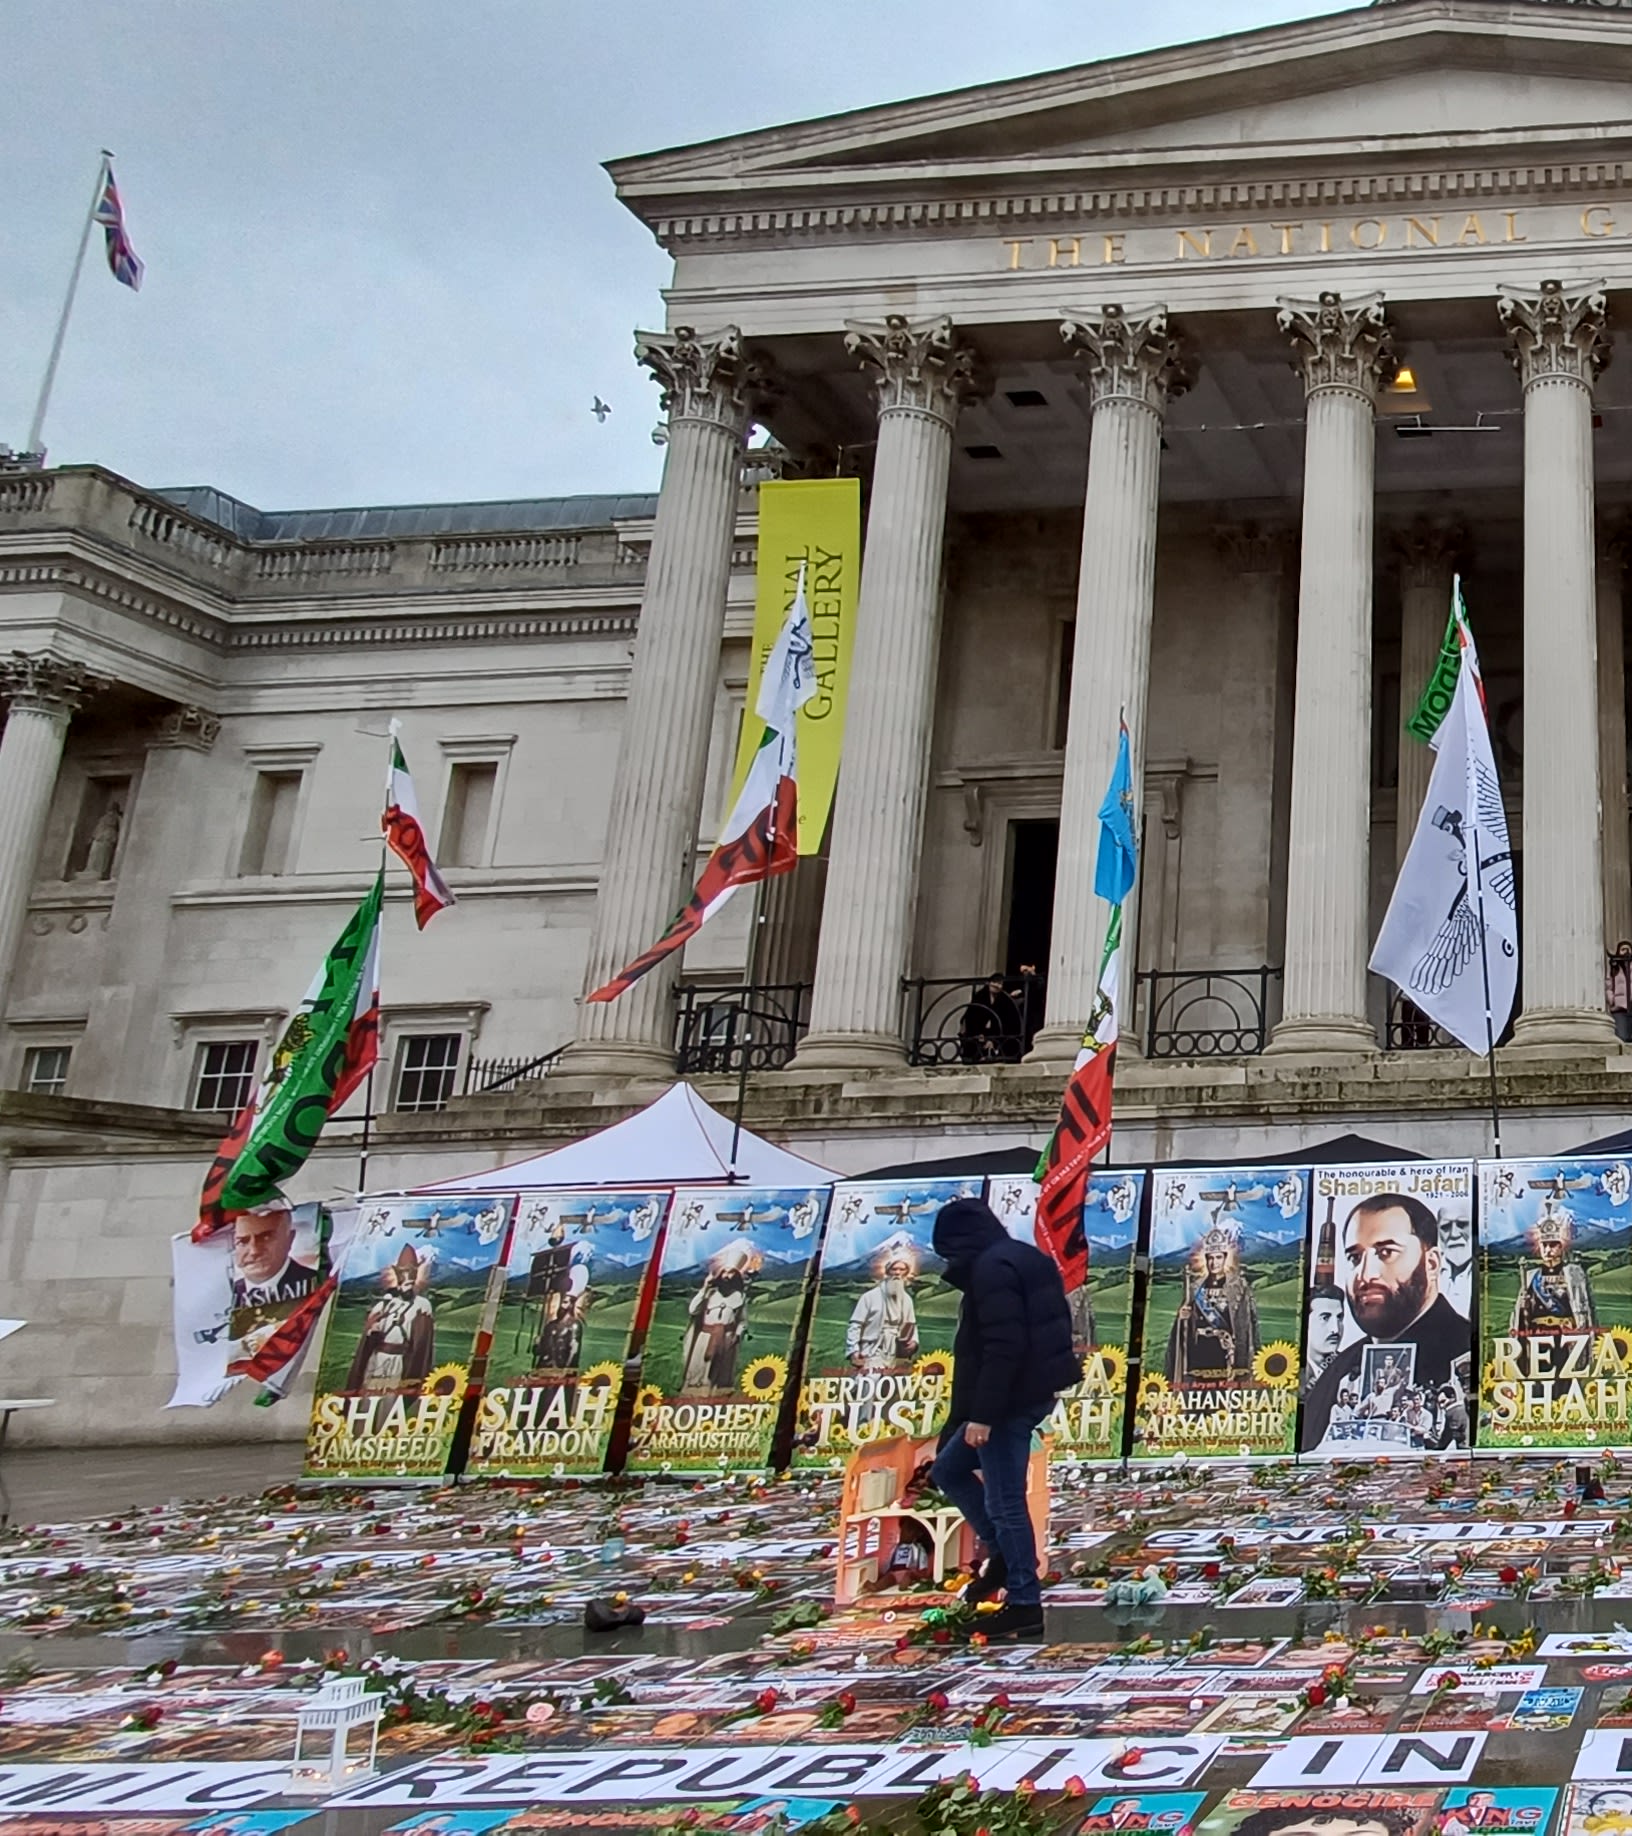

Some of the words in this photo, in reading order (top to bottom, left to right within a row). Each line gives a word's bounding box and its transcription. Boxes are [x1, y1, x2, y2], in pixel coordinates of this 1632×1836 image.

[1003, 236, 1126, 272] THE
[1177, 209, 1530, 263] NATIONAL
[1318, 1170, 1335, 1179] The
[1339, 1167, 1396, 1178] honourable
[1400, 1168, 1406, 1176] &
[1410, 1167, 1433, 1176] hero
[1435, 1166, 1446, 1175] of
[1449, 1166, 1469, 1174] Iran
[1318, 1178, 1400, 1197] Shaban
[1408, 1173, 1470, 1193] Jafari
[1493, 1332, 1628, 1380] REZA
[808, 1374, 944, 1402] FERDOWSI
[1145, 1388, 1288, 1412] SHAHANSHAH
[480, 1386, 609, 1432] SHAH
[1491, 1378, 1630, 1427] SHAH
[316, 1395, 452, 1439] SHAH
[640, 1403, 771, 1433] PROPHET
[810, 1400, 939, 1447] TUSI
[1145, 1412, 1284, 1438] ARYAMEHR
[316, 1436, 441, 1461] JAMSHEED
[477, 1429, 600, 1457] FRAYDON
[637, 1430, 760, 1451] ZARATHUSTHRA
[1147, 1521, 1612, 1547] GENOCIDE
[352, 1745, 1200, 1799] REPUBLIC
[1301, 1736, 1475, 1774] IN
[1226, 1791, 1438, 1810] GENOCIDE
